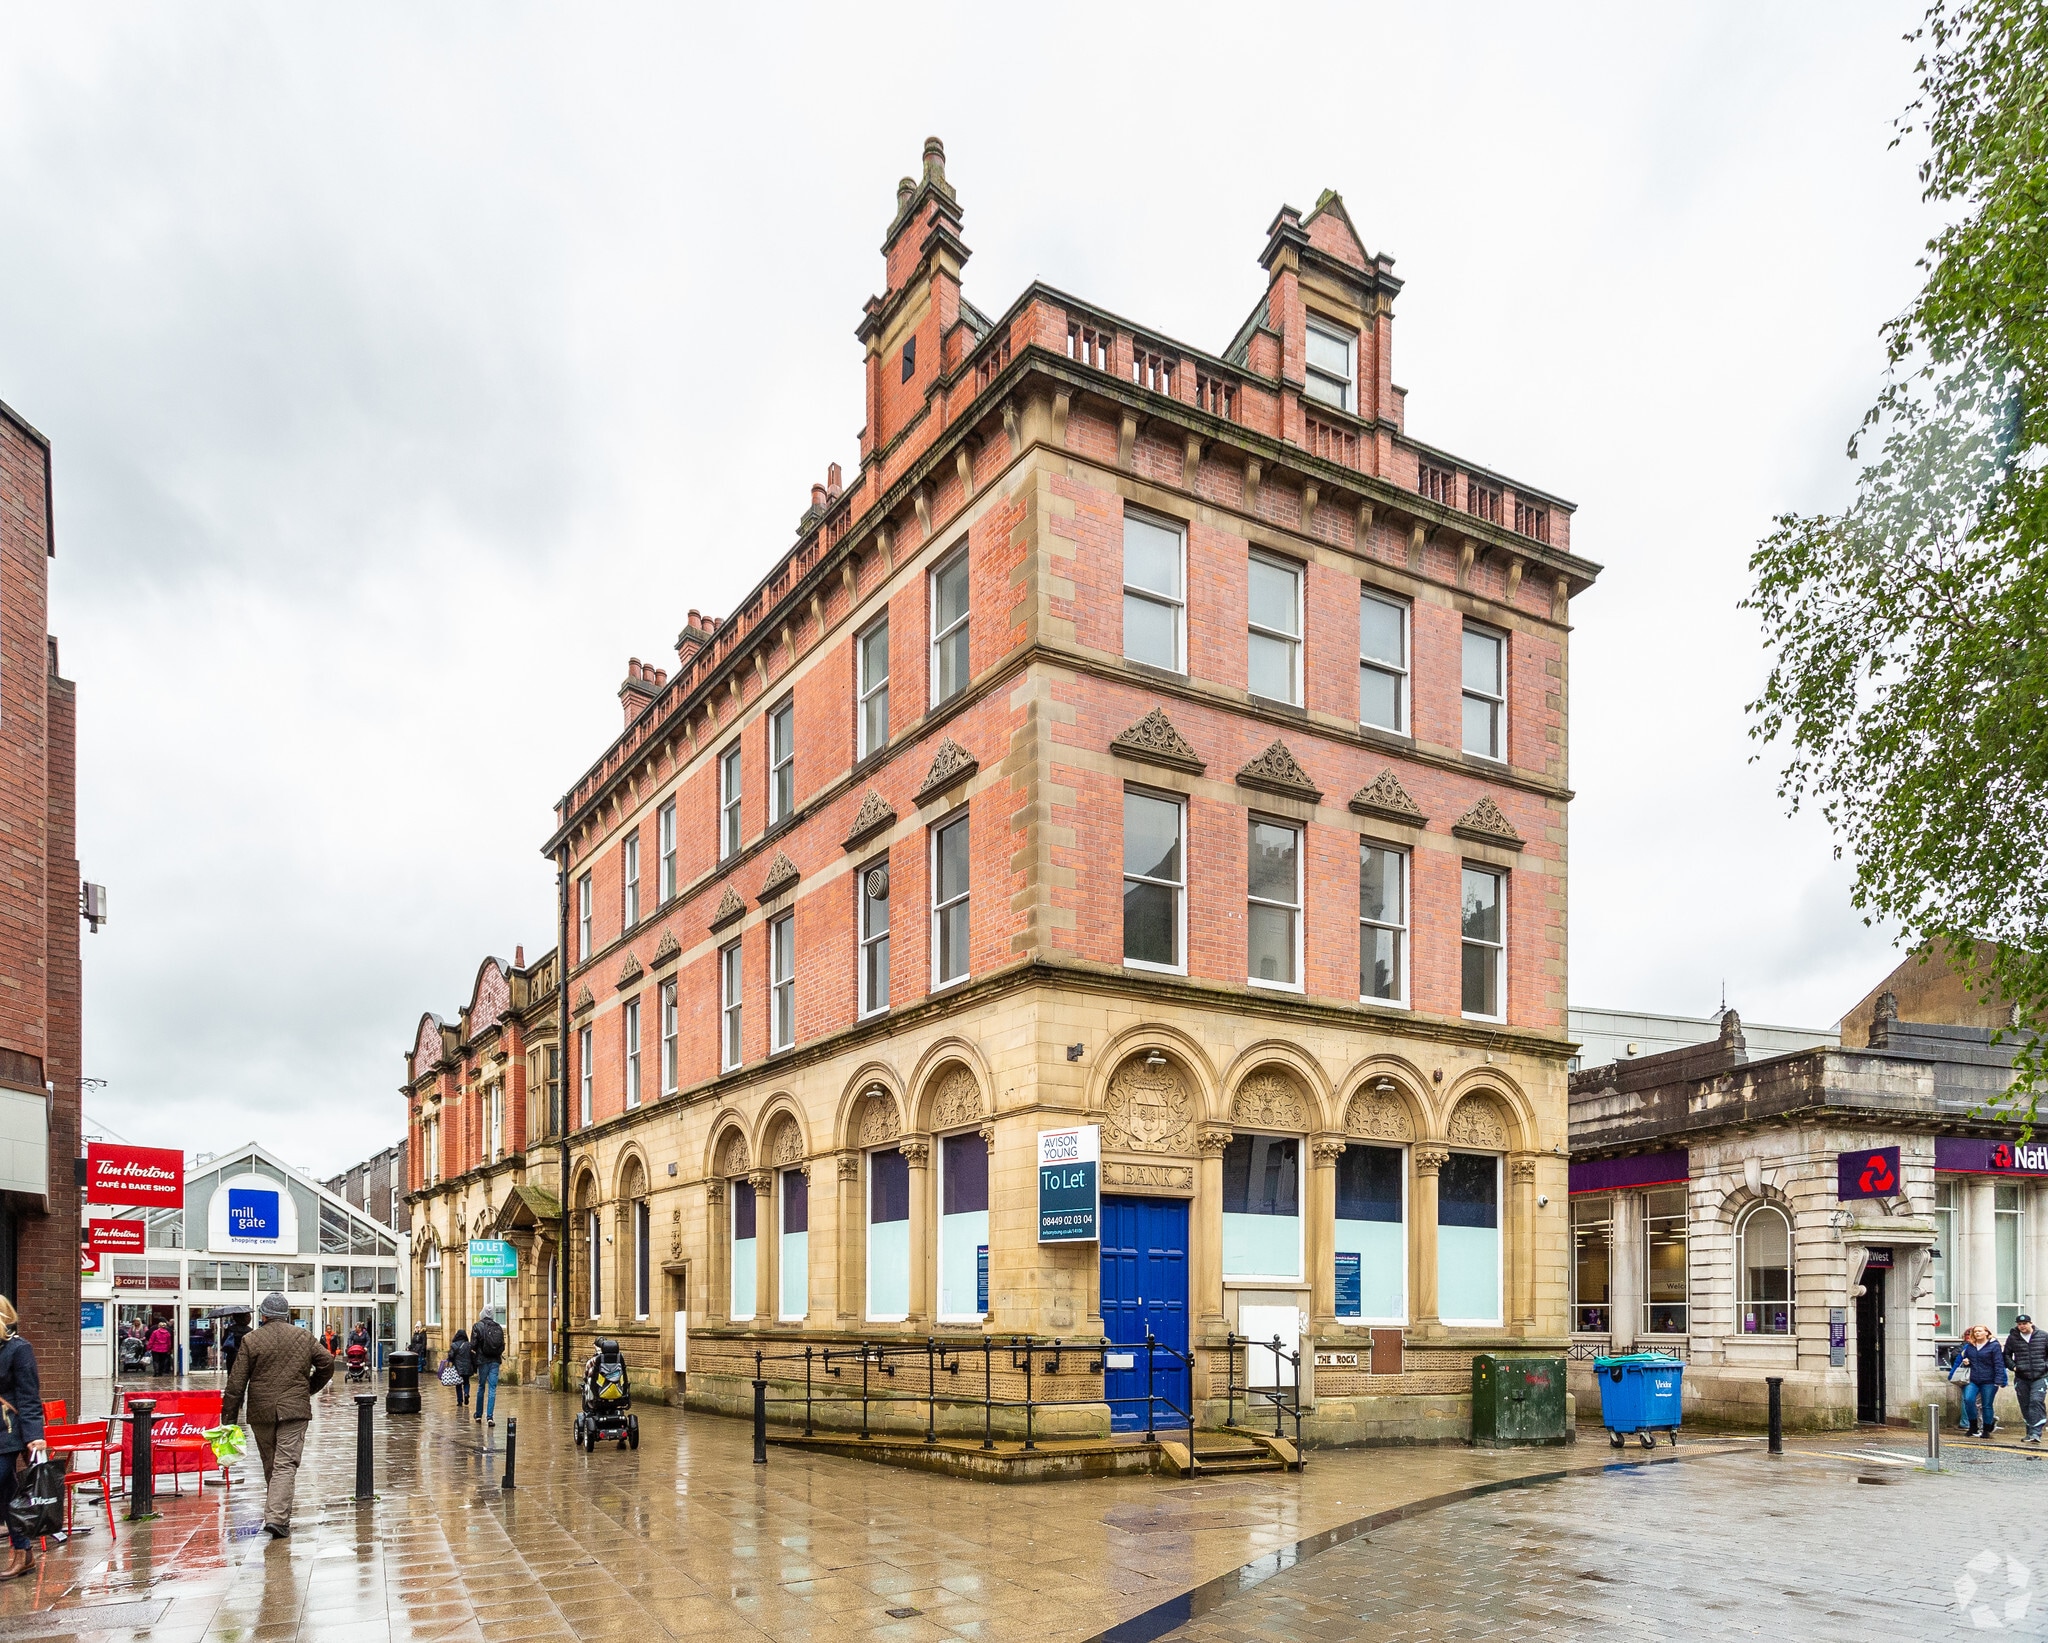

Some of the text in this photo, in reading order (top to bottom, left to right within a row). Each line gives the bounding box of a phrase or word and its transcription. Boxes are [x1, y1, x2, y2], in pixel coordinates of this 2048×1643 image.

[1044, 1135, 1077, 1148] AVISON
[1044, 1146, 1078, 1159] YOUNG
[2015, 1145, 2048, 1170] Nat
[96, 1160, 175, 1179] Tim Hortons
[1122, 1165, 1174, 1187] BANK
[1041, 1169, 1085, 1190] To Let
[96, 1181, 119, 1189] CAFÉ
[153, 1184, 176, 1192] SHOP
[231, 1206, 254, 1218] mill
[238, 1217, 266, 1230] gate
[1042, 1214, 1093, 1226] 08449 02 03 04
[94, 1227, 140, 1238] Tim Hortons
[471, 1242, 504, 1252] TO LET
[1869, 1251, 1889, 1261] tWest
[1317, 1354, 1356, 1364] THE ROCK
[160, 1421, 206, 1436] Hotons
